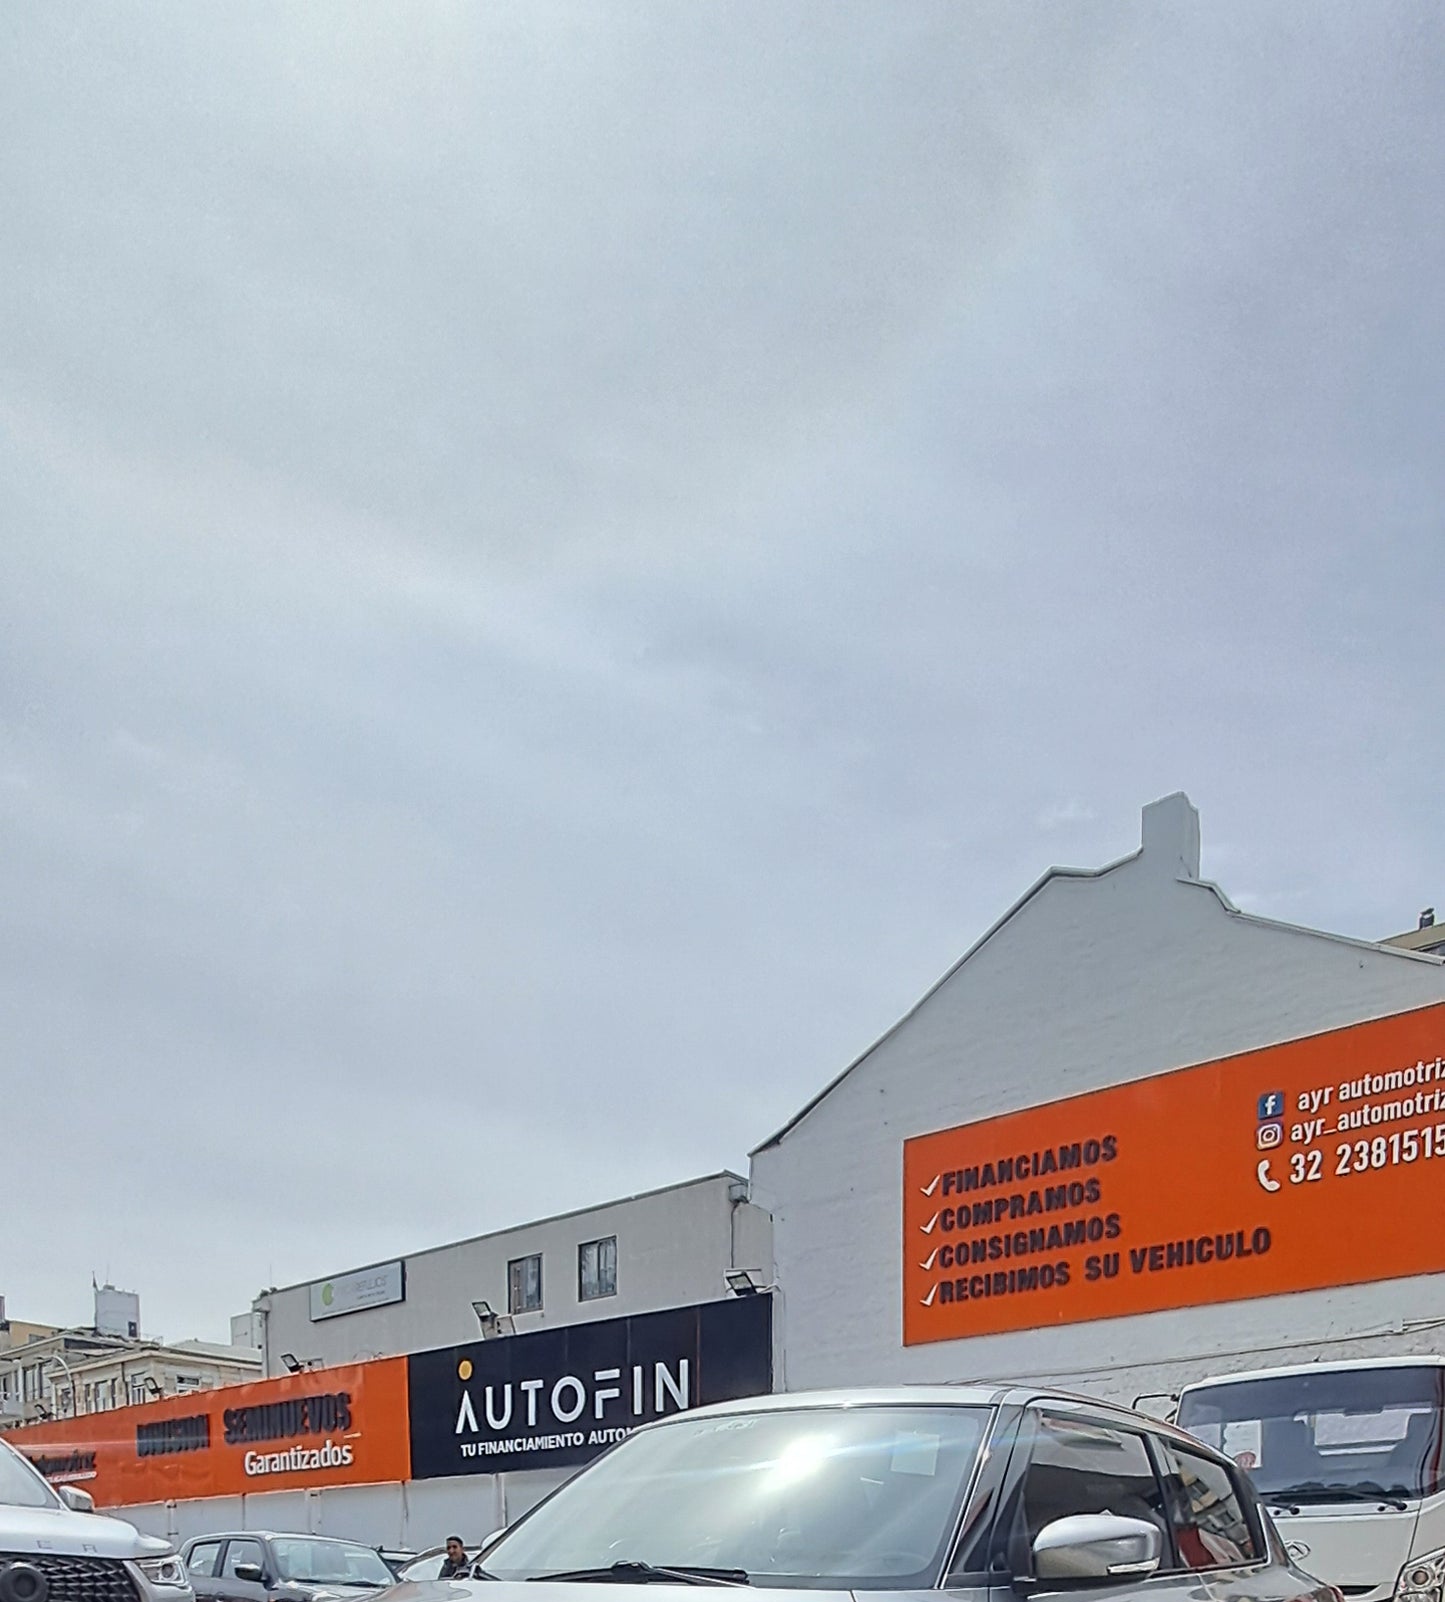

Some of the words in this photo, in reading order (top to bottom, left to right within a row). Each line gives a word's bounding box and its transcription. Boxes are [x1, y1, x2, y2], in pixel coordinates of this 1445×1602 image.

[1298, 1086, 1334, 1113] ayr
[942, 1135, 1118, 1195] FINANCIAMOS
[1289, 1149, 1322, 1184] 32
[1334, 1123, 1445, 1176] 2381515
[940, 1178, 1100, 1232] COMPRAMOS
[939, 1213, 1121, 1268] CONSIGNAMOS
[939, 1262, 1070, 1304] RECIBIMOS
[1085, 1252, 1120, 1281] SU
[1130, 1227, 1272, 1274] VEHICULO
[455, 1358, 690, 1435] AUTOFIN
[244, 1439, 353, 1476] Garantizados
[460, 1443, 476, 1457] TU
[478, 1431, 584, 1456] FINANCIAMIENTO
